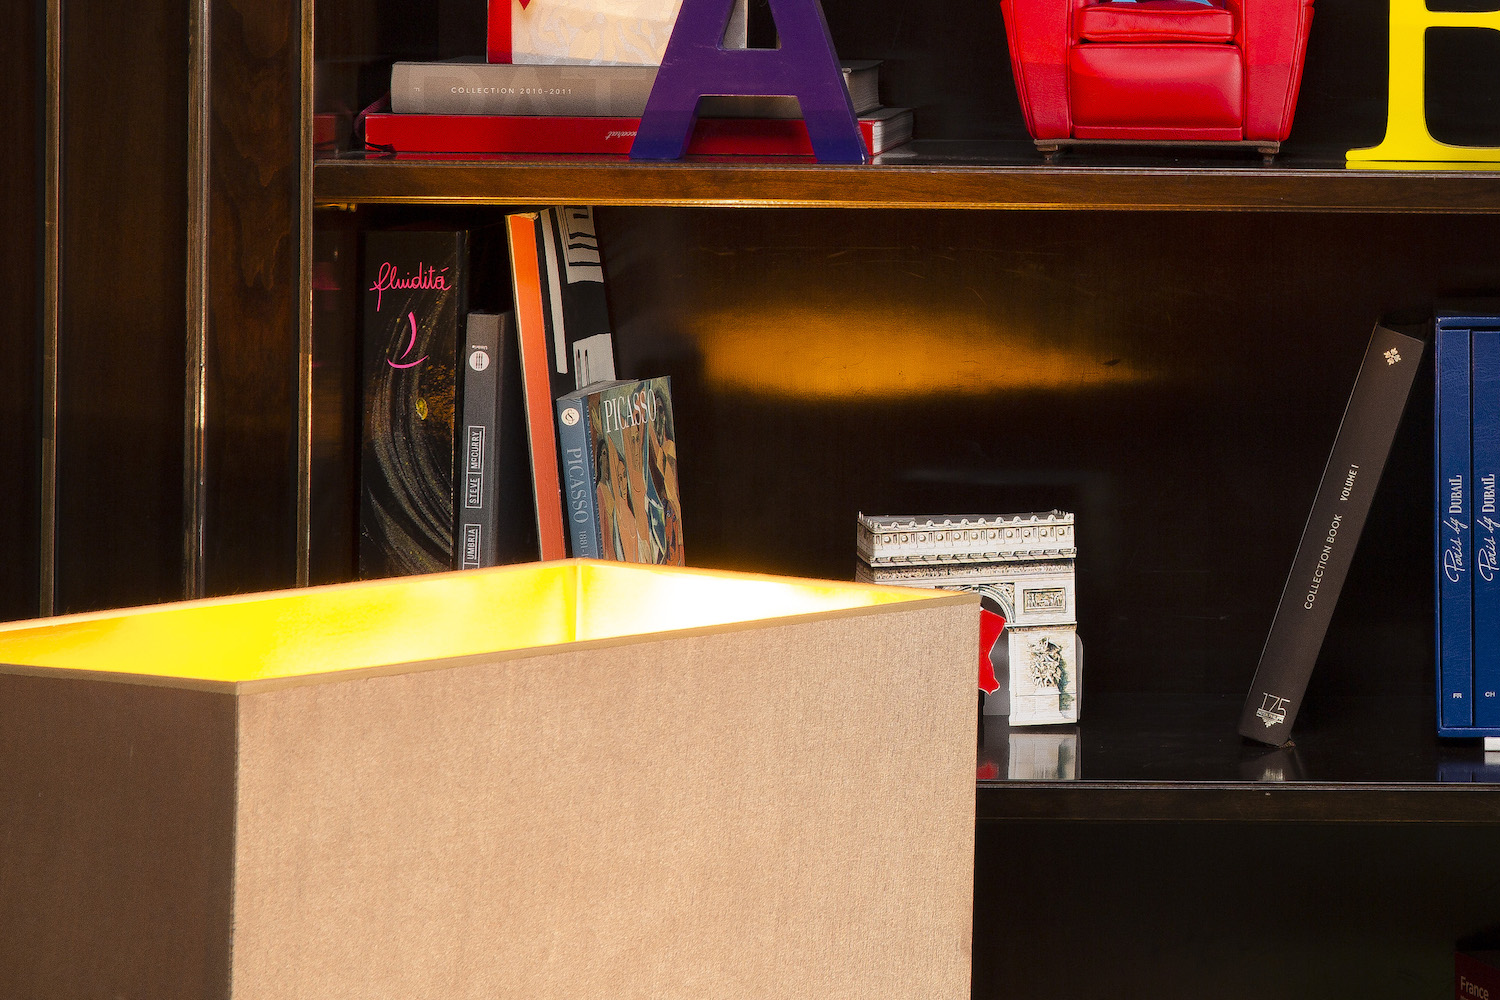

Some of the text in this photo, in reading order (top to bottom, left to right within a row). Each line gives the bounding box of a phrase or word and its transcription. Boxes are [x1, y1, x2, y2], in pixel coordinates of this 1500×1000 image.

[451, 86, 516, 95] COLLECTION
[603, 388, 657, 433] PICASSO
[468, 478, 479, 504] STEVE
[566, 447, 589, 523] PICASSO
[466, 528, 477, 560] UMBRIA
[1304, 546, 1332, 610] COLLECTION
[1326, 514, 1343, 544] BOOK
[1340, 470, 1358, 501] VOLUME
[1443, 516, 1468, 534] by
[1444, 537, 1466, 582] Paris
[1478, 536, 1500, 581] Paris
[1460, 976, 1490, 999] France
